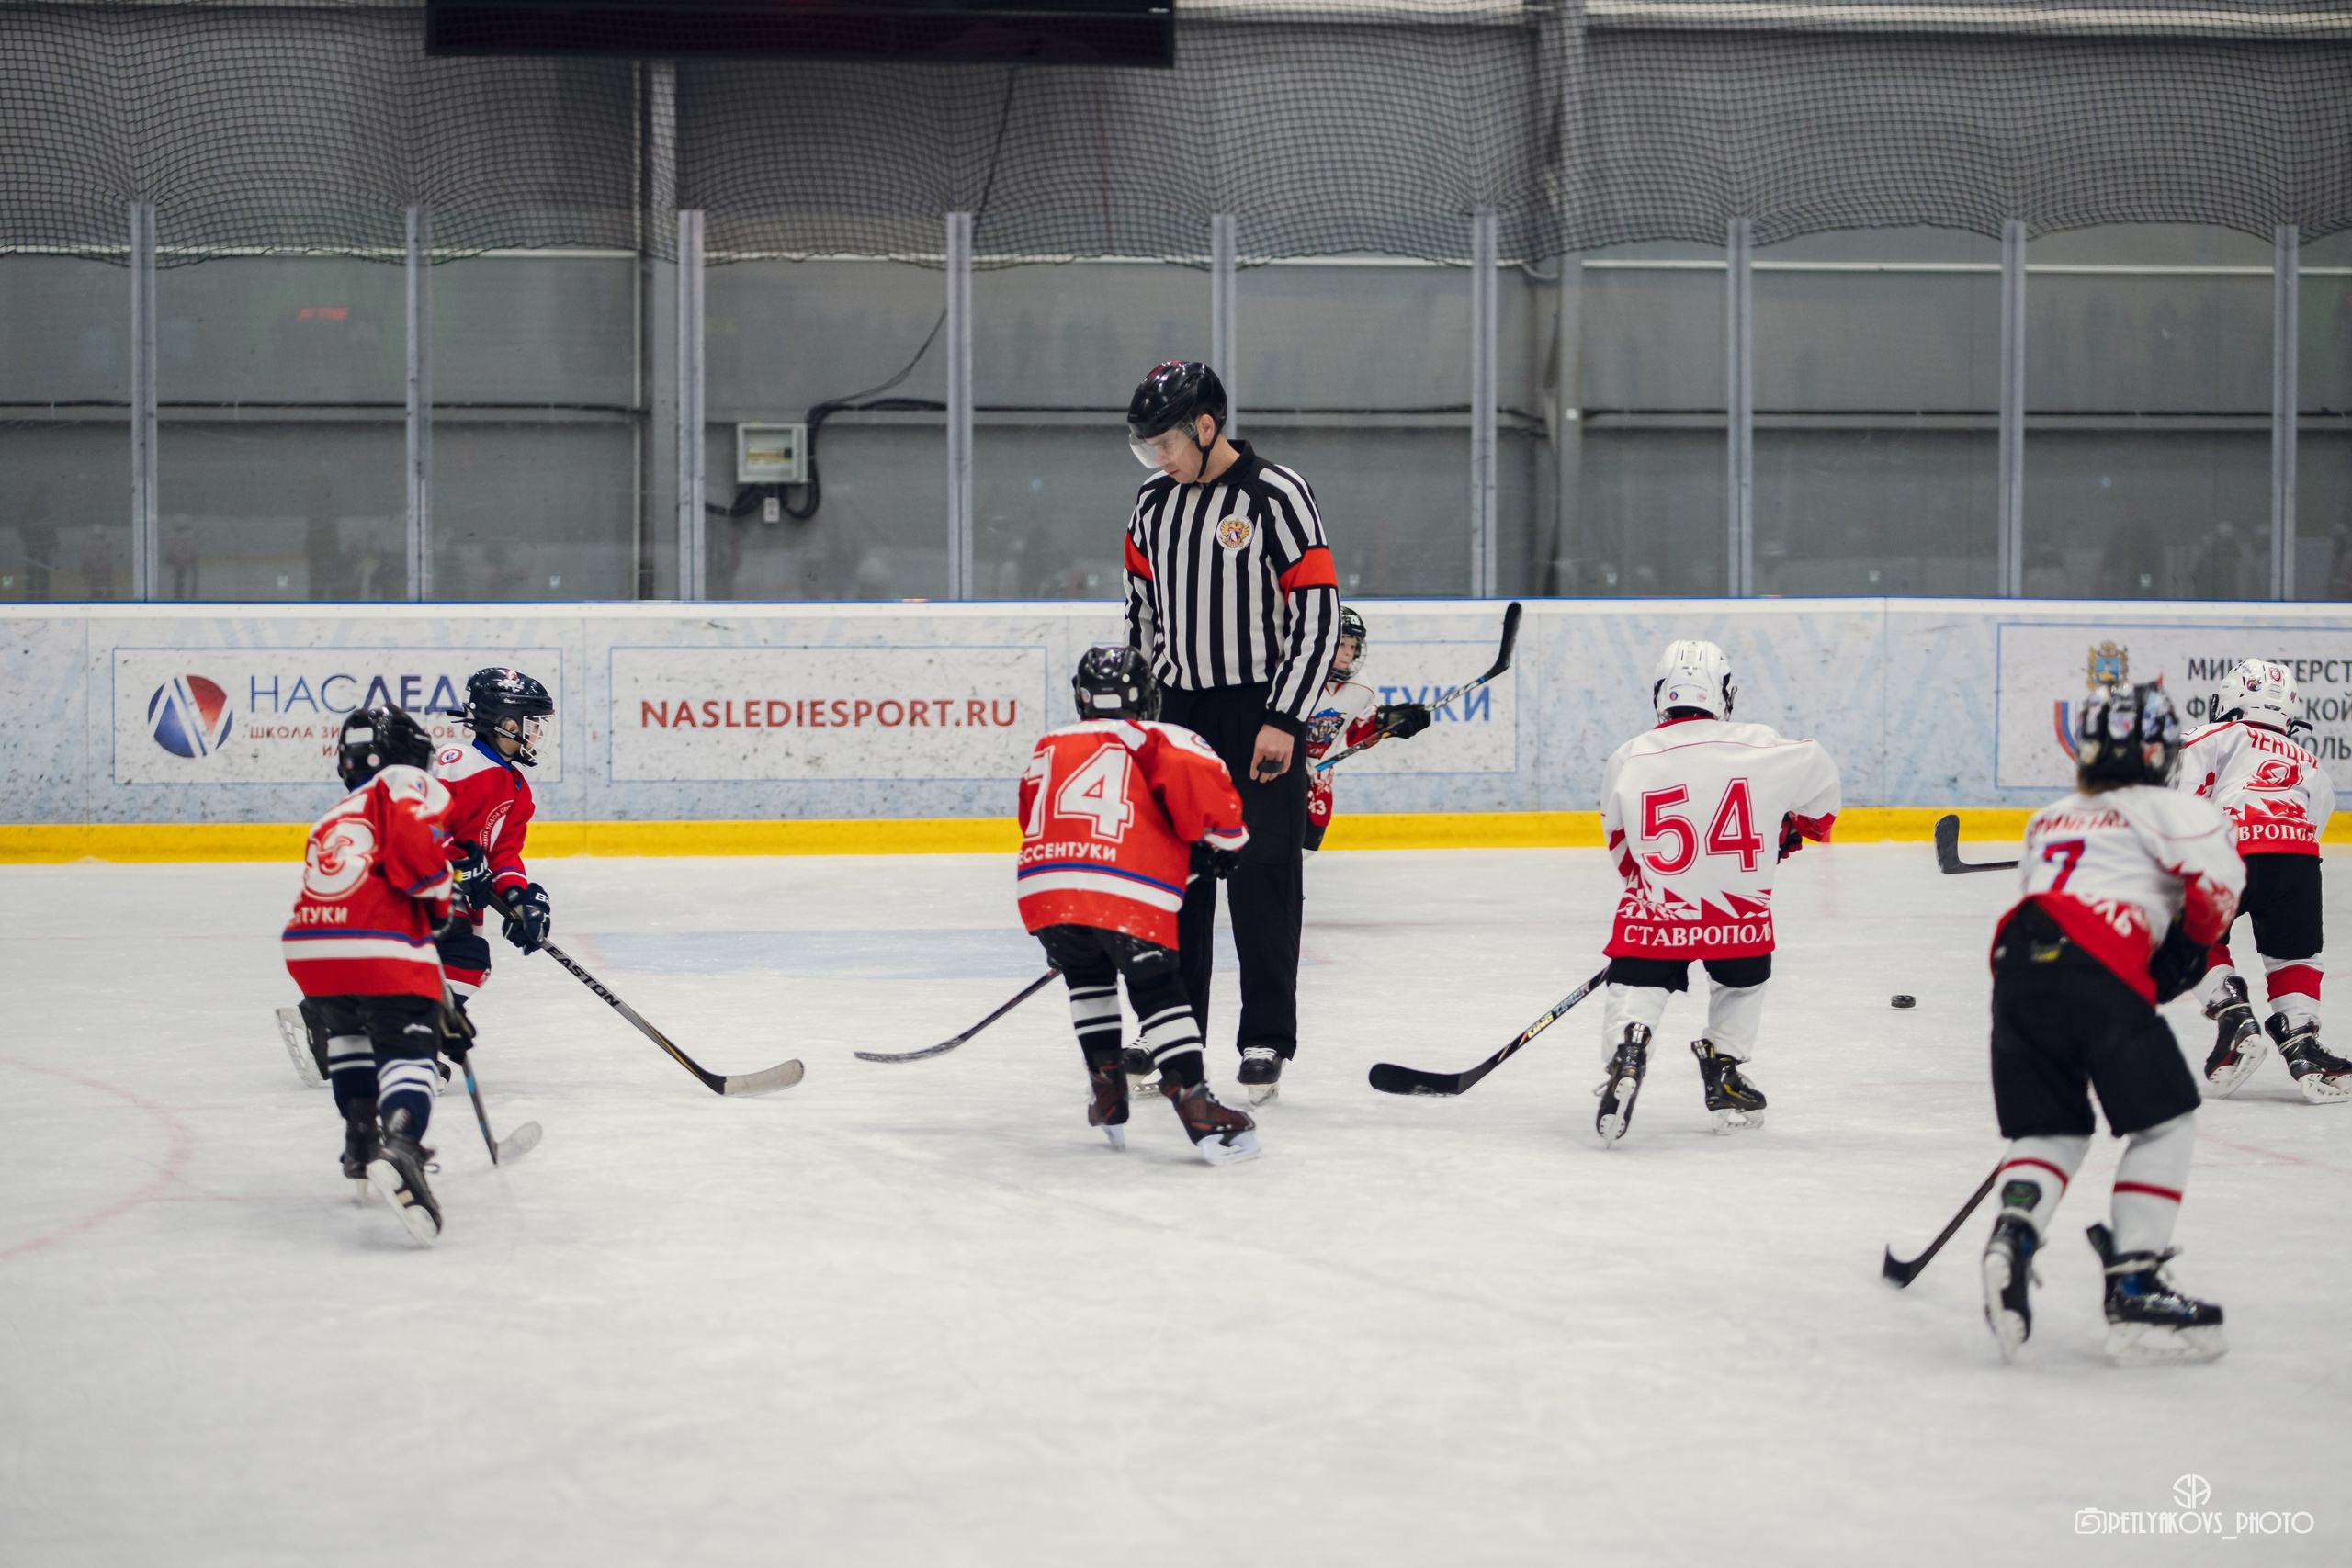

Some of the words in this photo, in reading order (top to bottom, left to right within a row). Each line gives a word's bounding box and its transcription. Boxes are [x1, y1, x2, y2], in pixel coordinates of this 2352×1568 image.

[250, 673, 472, 716] НАСЛЕД
[640, 698, 1018, 728] NASLEDIESPORT.RU
[250, 725, 314, 739] ШКОЛА
[1640, 777, 1764, 876] 54
[2042, 839, 2085, 893] 7
[546, 946, 621, 1007] EASTON
